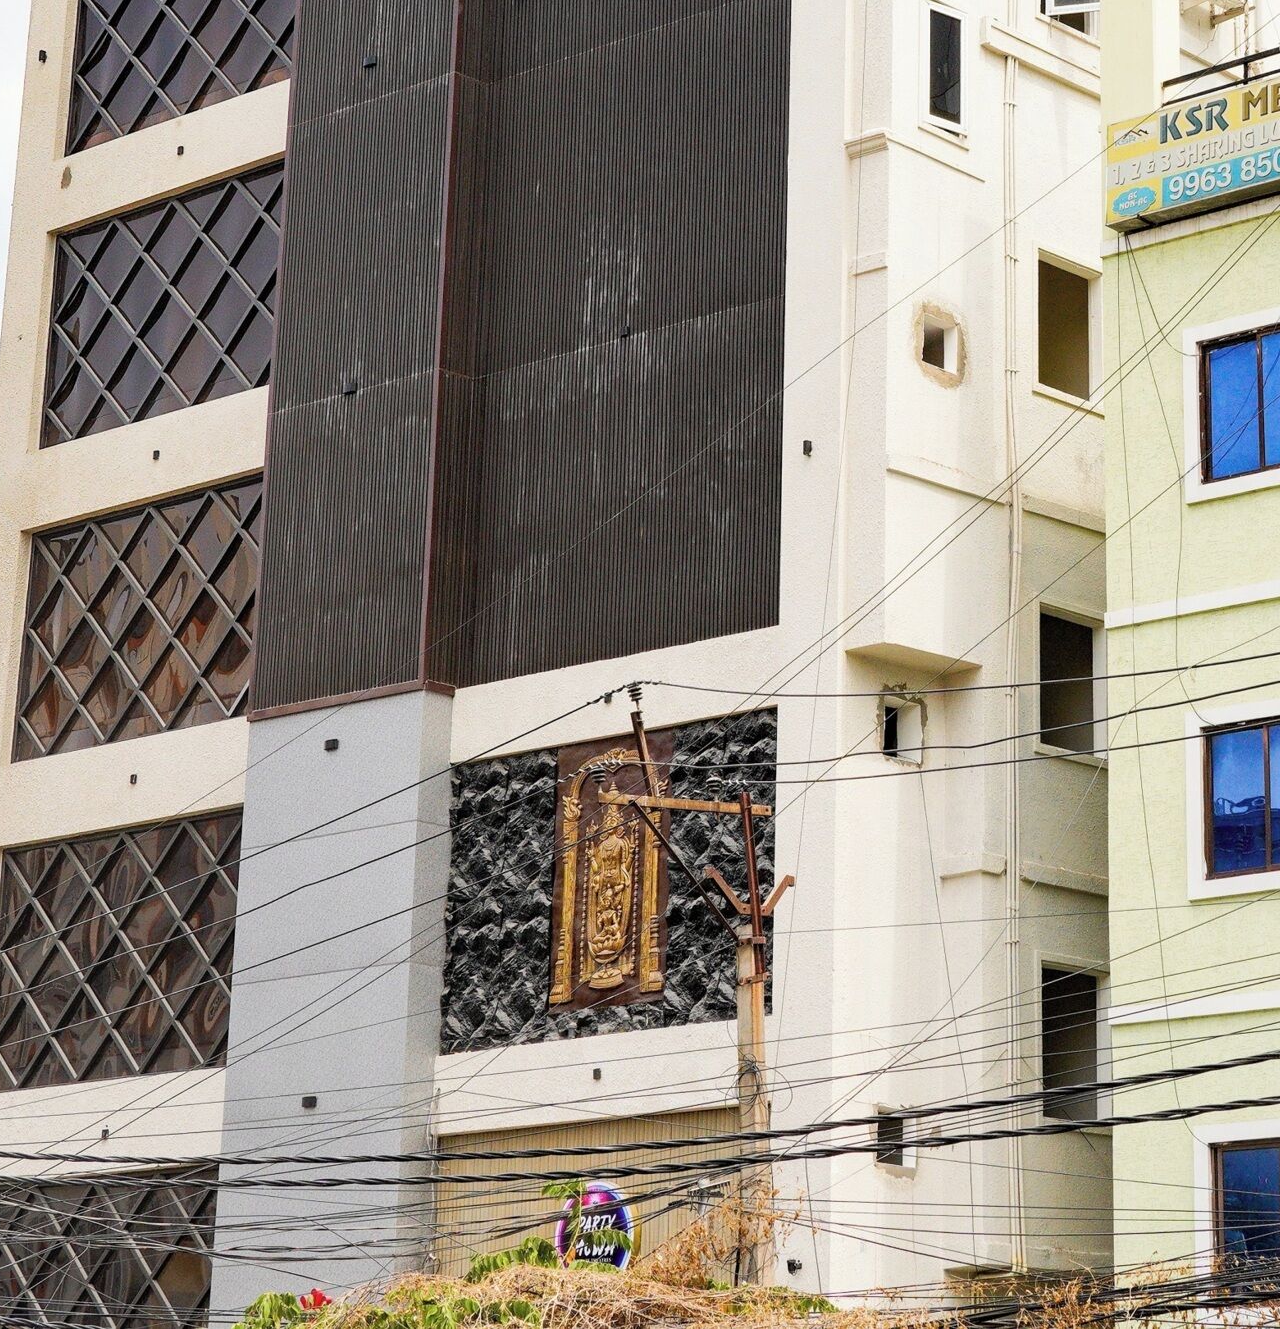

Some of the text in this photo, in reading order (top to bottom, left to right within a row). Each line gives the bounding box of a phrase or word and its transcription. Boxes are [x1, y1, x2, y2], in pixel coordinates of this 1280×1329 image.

[1160, 98, 1229, 144] KSR
[1160, 153, 1172, 172] 3
[1176, 128, 1254, 168] SHARING
[1168, 163, 1233, 201] 9963
